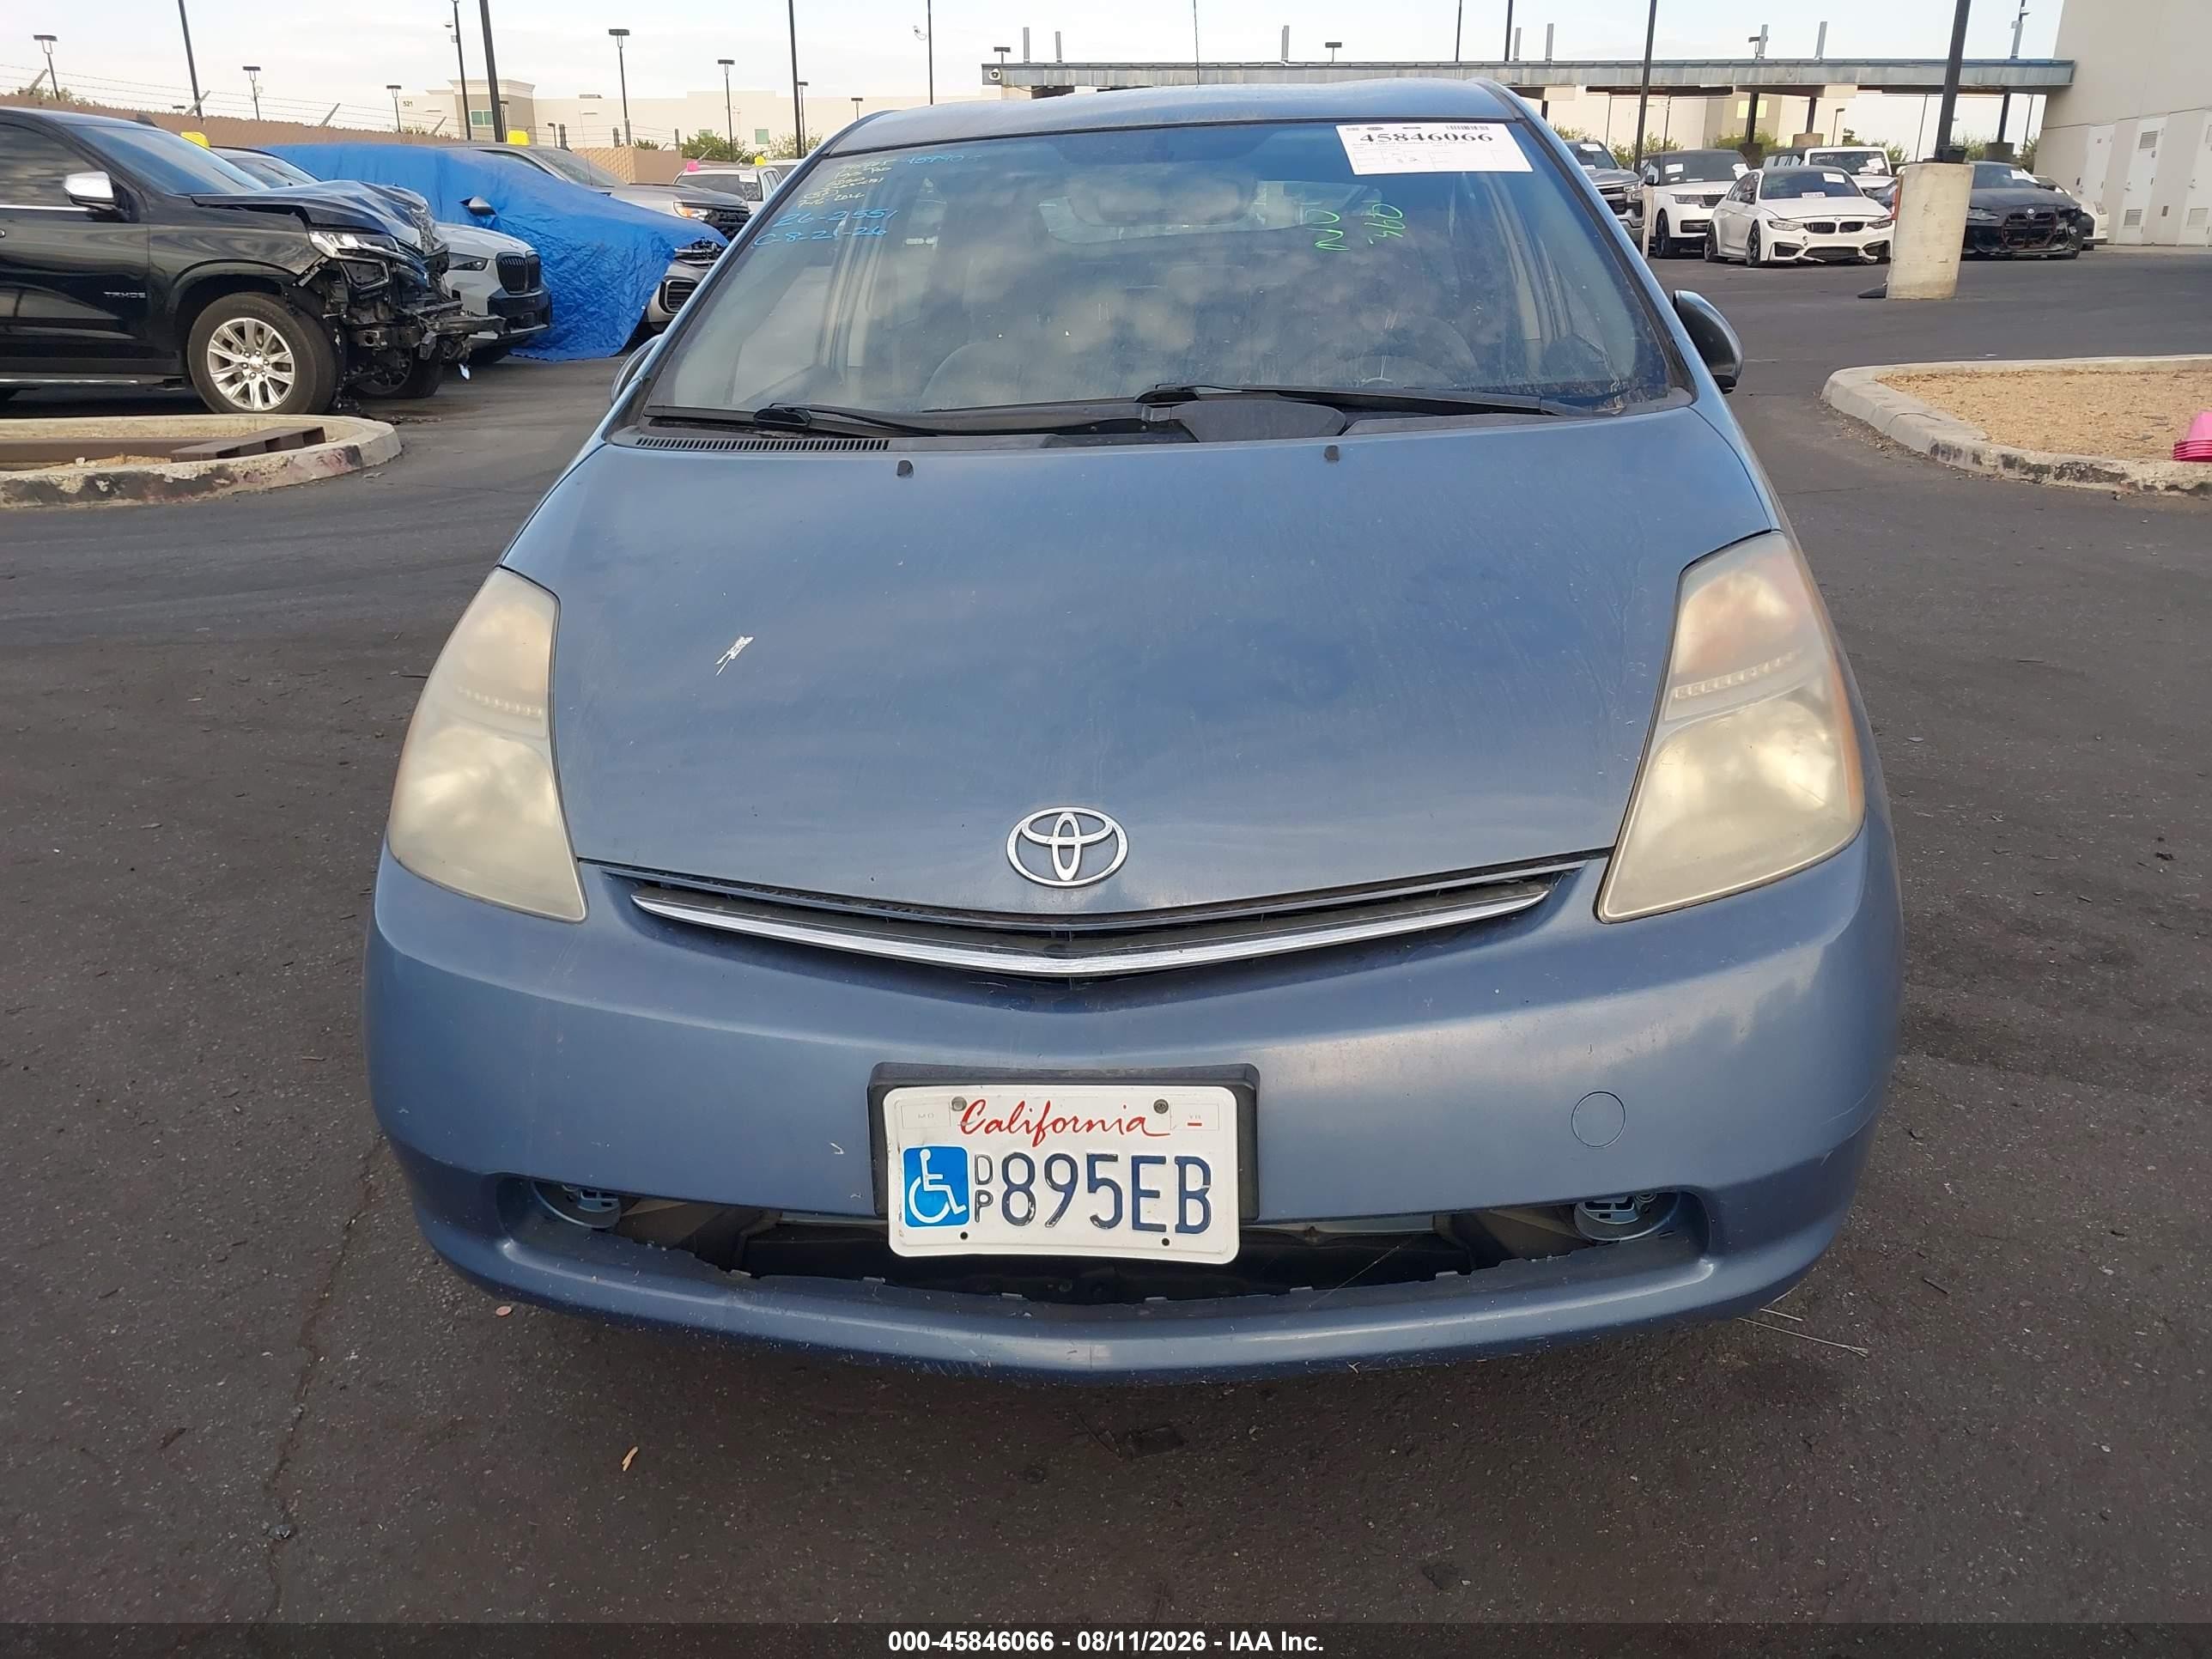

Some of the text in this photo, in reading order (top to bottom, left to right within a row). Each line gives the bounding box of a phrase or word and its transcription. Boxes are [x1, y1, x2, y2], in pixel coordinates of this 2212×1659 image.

[1360, 132, 1493, 143] 45846066
[960, 1099, 1171, 1147] California
[1001, 1152, 1212, 1235] 895EB
